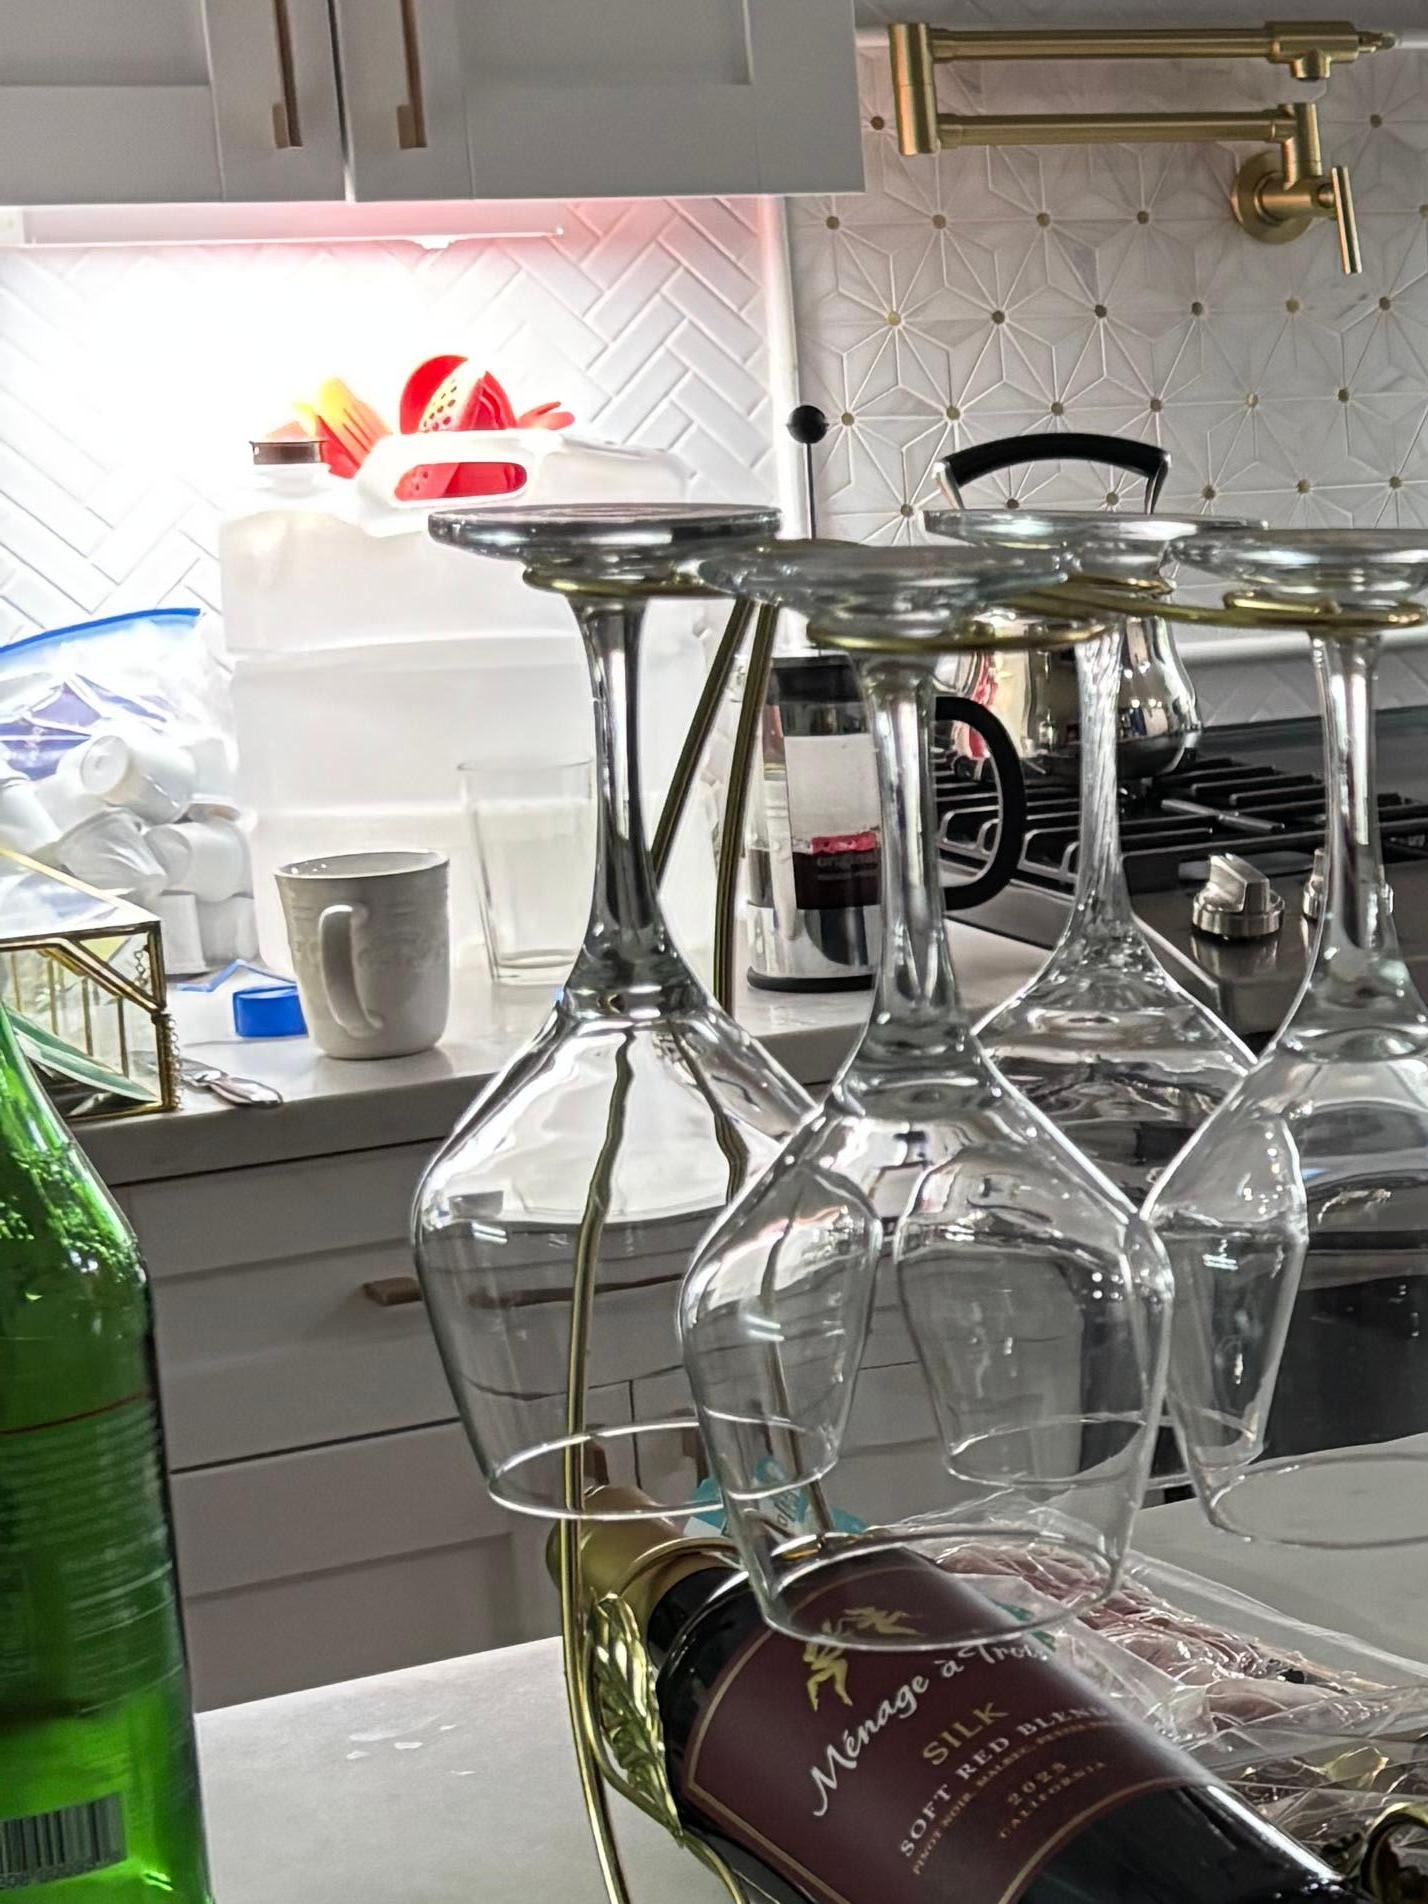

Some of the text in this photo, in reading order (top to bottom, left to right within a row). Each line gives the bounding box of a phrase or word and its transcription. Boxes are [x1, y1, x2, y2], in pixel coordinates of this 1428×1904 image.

[809, 1644, 1047, 1817] Ménage à Troi
[923, 1701, 1009, 1765] SILK
[901, 1784, 952, 1856] SOFT
[956, 1737, 1010, 1780] RED
[998, 1760, 1107, 1839] CALIFORNIA
[913, 1830, 943, 1875] PINOT
